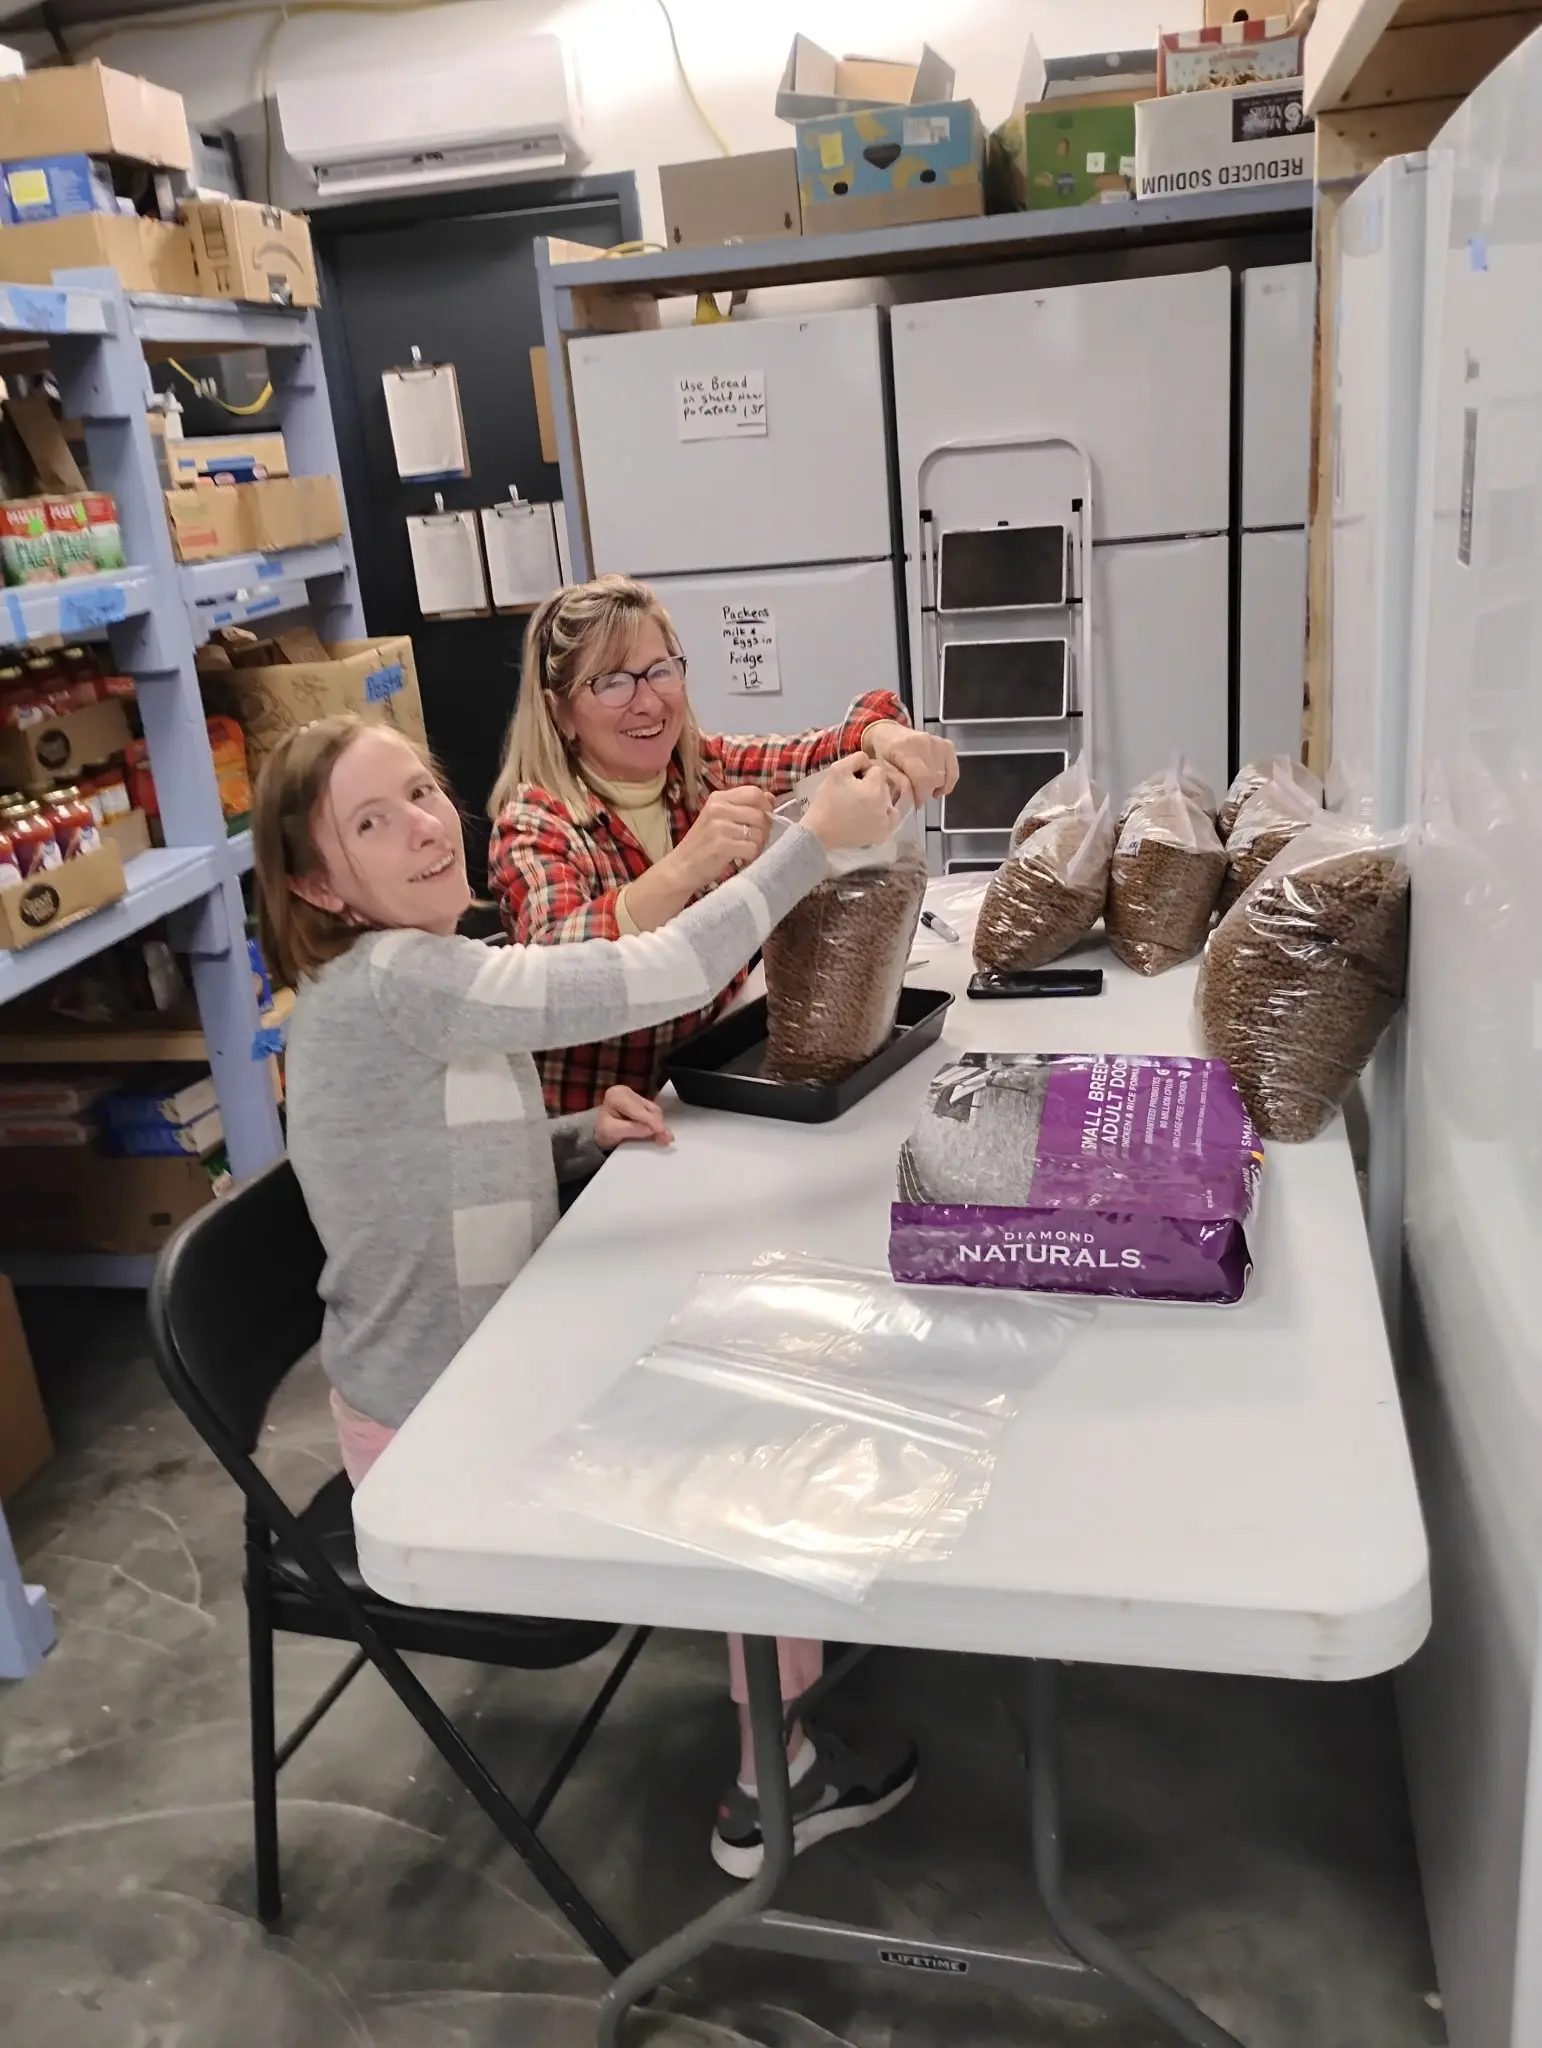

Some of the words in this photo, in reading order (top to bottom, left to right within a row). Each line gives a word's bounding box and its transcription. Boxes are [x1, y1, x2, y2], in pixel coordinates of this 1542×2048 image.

[1142, 169, 1212, 195] SODIUM
[1218, 157, 1304, 186] REDUCED
[680, 379, 704, 392] Use
[711, 374, 747, 391] Bread
[722, 605, 770, 620] Packers
[729, 651, 764, 670] Fridge
[1088, 1063, 1109, 1102] BREED
[1109, 1061, 1128, 1089] DOG
[1126, 1091, 1137, 1112] RICE
[1149, 1076, 1161, 1108] PROBIOTICS
[1177, 1080, 1188, 1105] CHICKEN
[1101, 1090, 1123, 1145] ADULT
[1160, 1095, 1172, 1120] MILLION
[1080, 1107, 1102, 1150] SMALL
[1173, 1105, 1185, 1137] CAGE-FREE
[1004, 1230, 1095, 1244] DIAMOND
[958, 1243, 1142, 1269] NATURALS
[888, 1952, 960, 1971] LIFETIME
